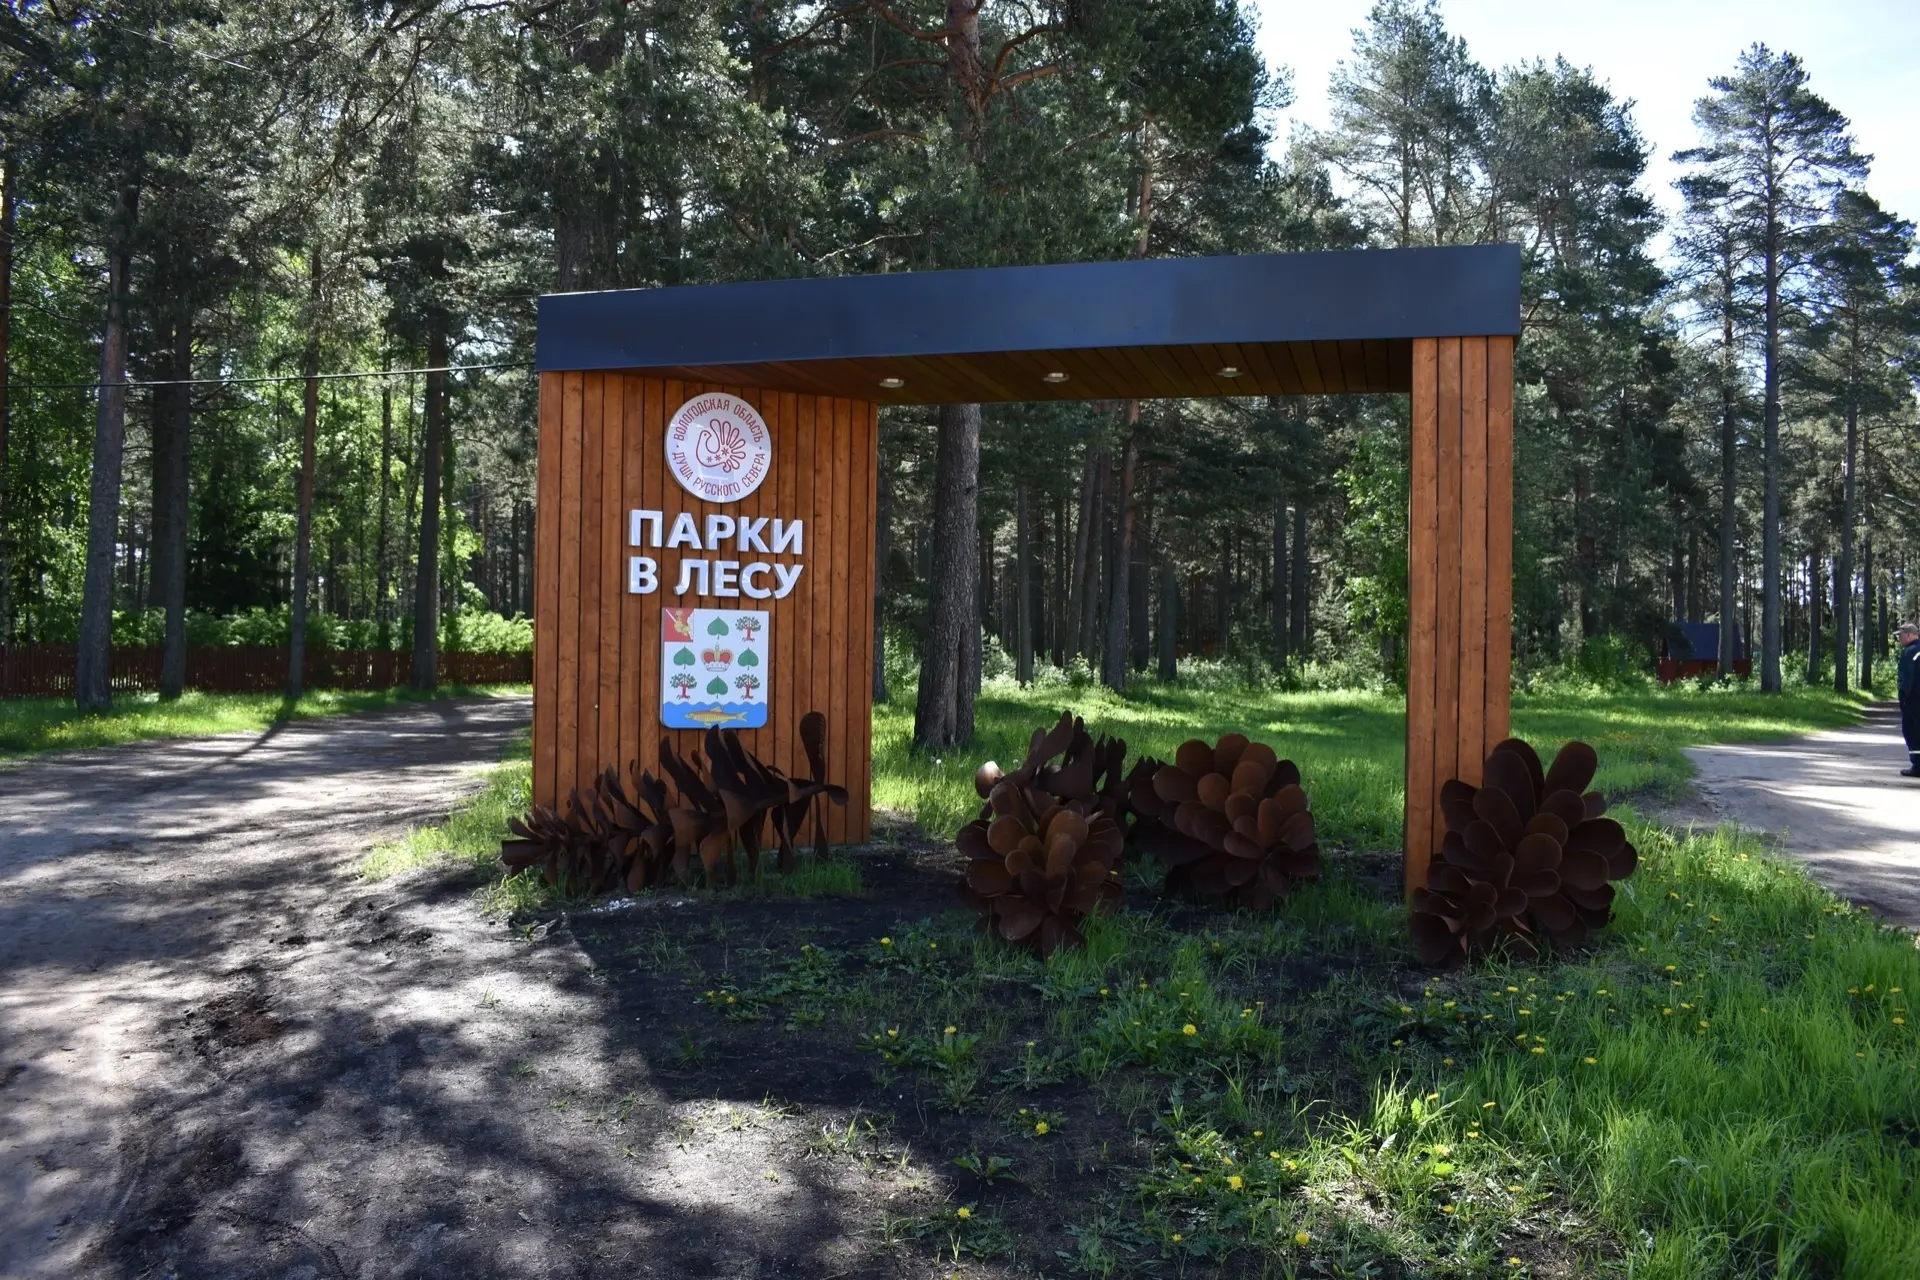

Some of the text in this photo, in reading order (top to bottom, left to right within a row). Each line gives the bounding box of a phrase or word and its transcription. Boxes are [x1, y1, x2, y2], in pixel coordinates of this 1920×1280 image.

[673, 398, 764, 443] ВОЛОГОДСКАЯ ОБЛАСТЬ
[672, 451, 765, 496] ДУША РУССКОГО СЕВЕРА
[628, 509, 803, 555] ПАРКИ
[628, 556, 804, 599] В ЛЕСУ
